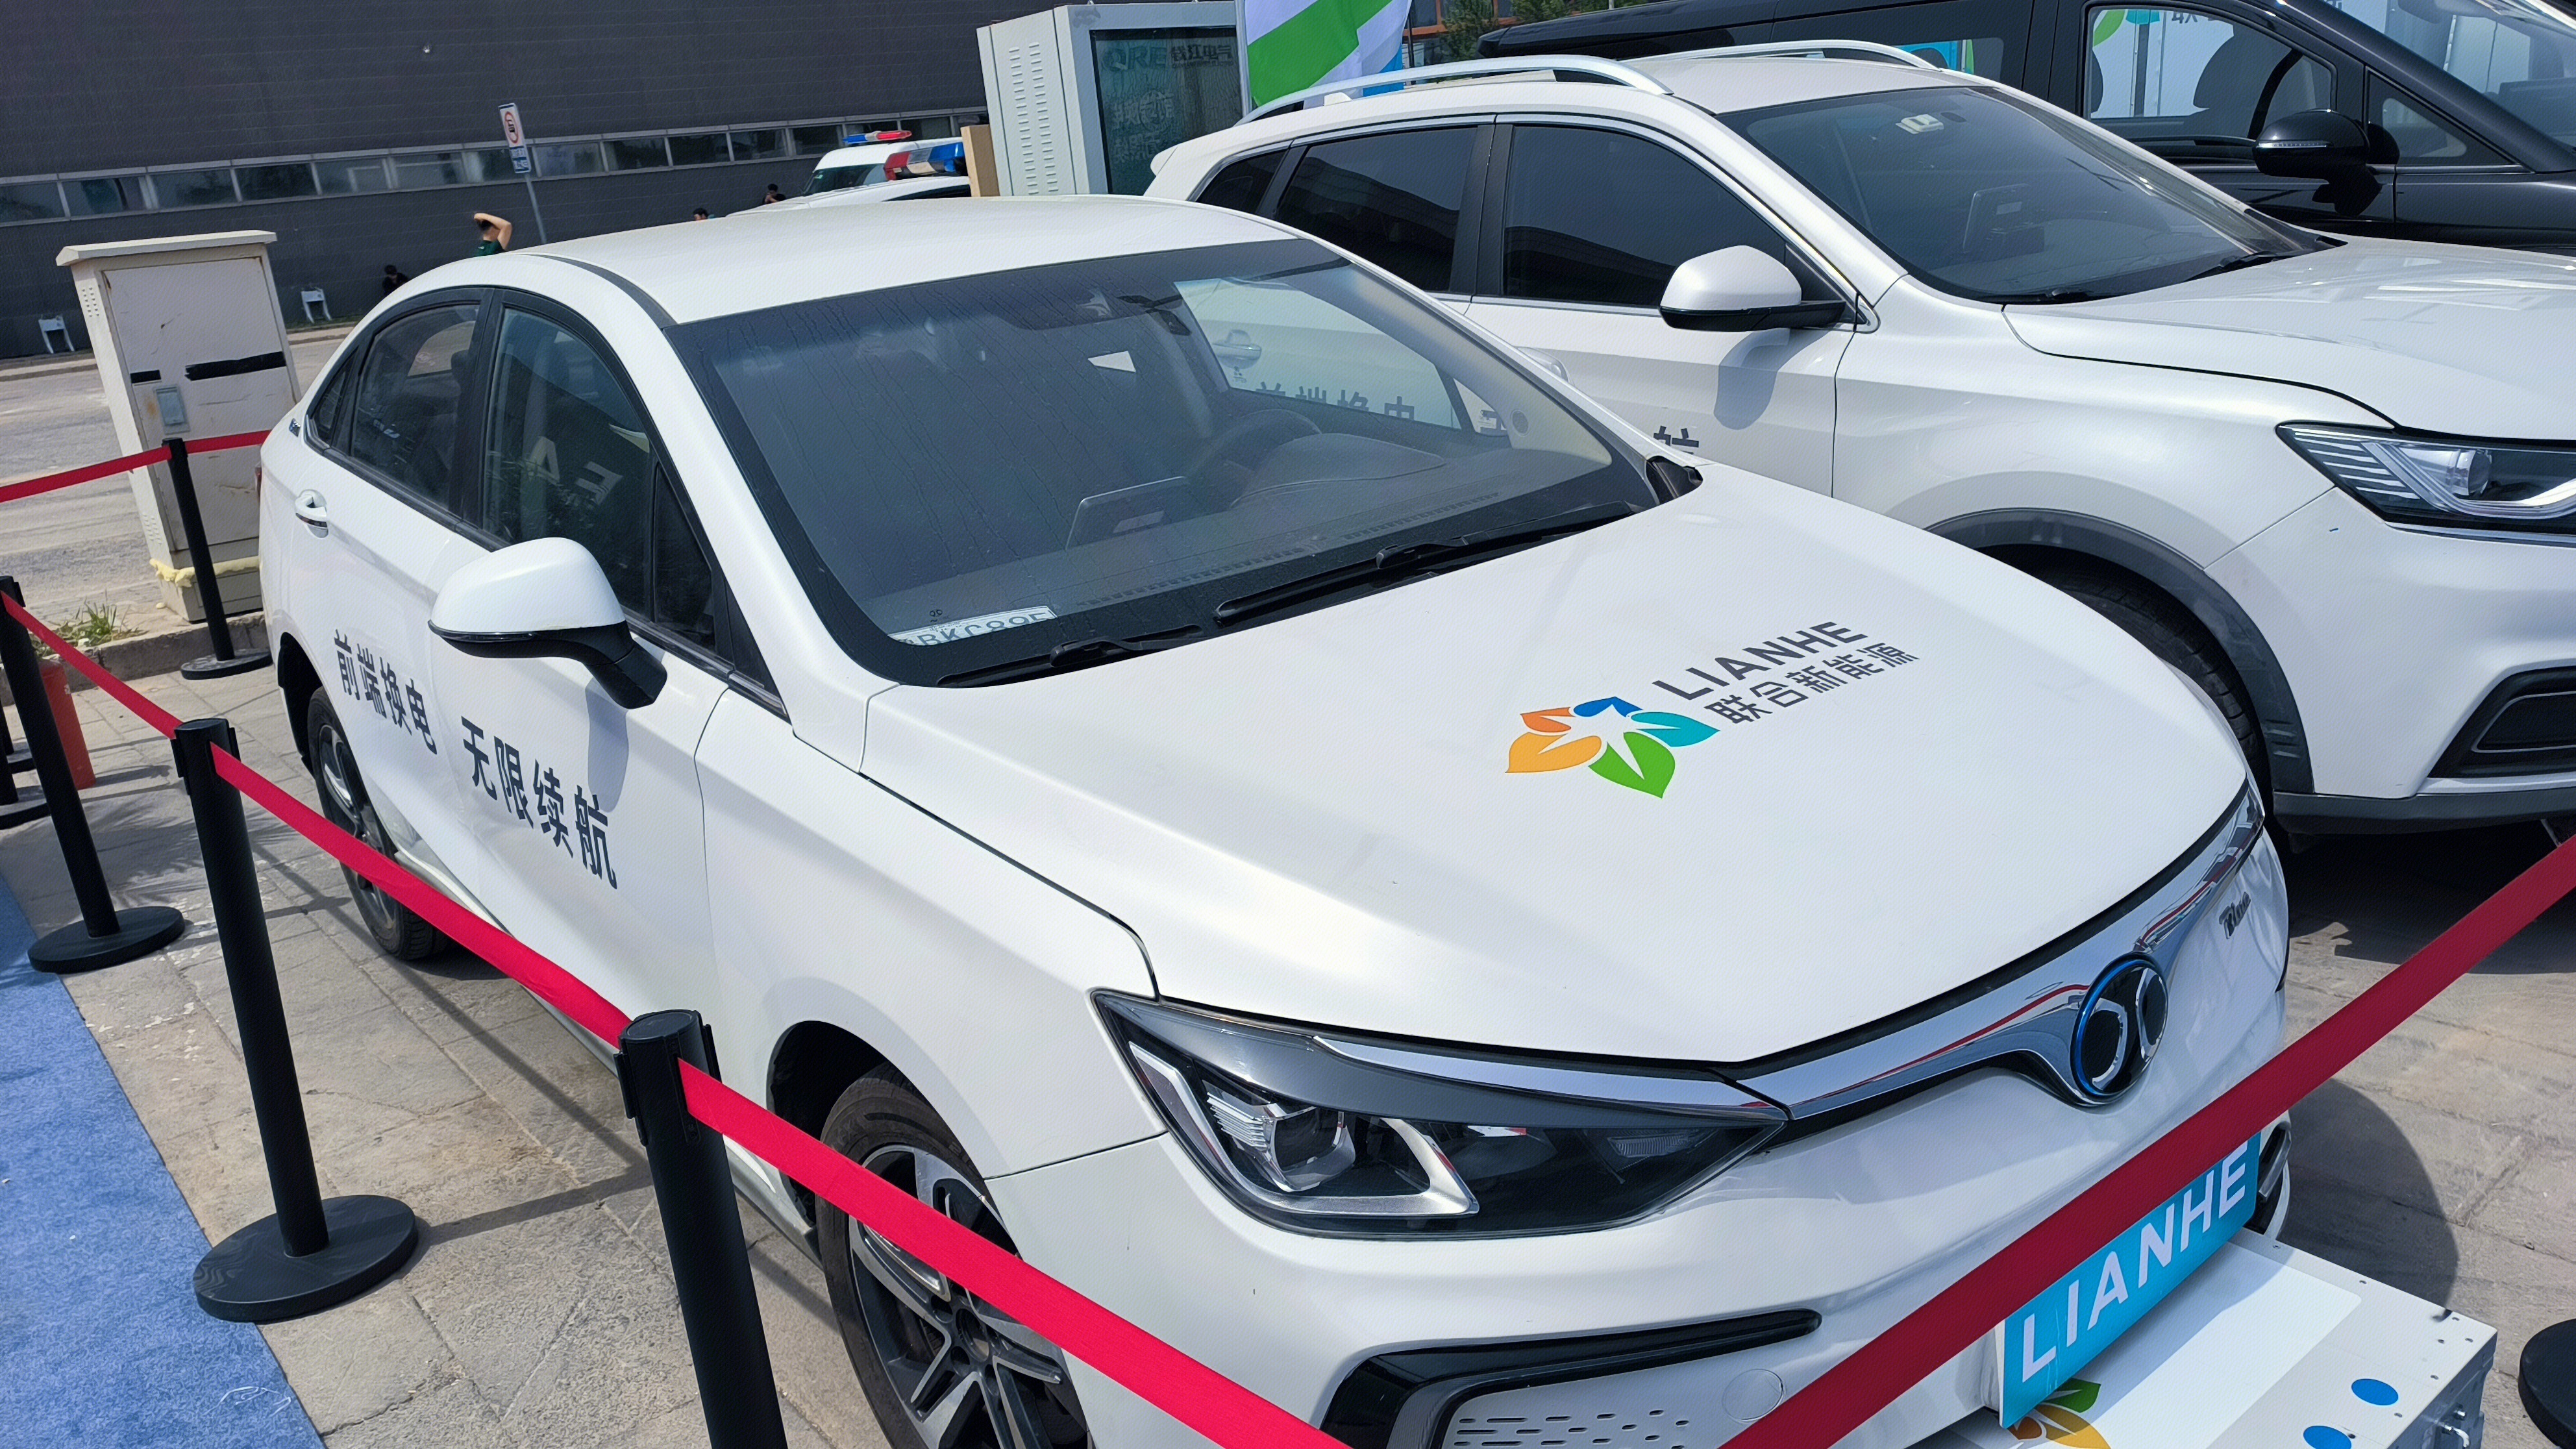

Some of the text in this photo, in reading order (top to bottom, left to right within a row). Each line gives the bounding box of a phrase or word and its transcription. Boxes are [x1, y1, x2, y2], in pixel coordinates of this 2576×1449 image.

[1652, 621, 1868, 700] LIANHE
[1703, 642, 1920, 724] 联合新能源
[334, 628, 617, 889] 前端换电 无限续航
[2022, 1140, 2248, 1383] LIANHE
